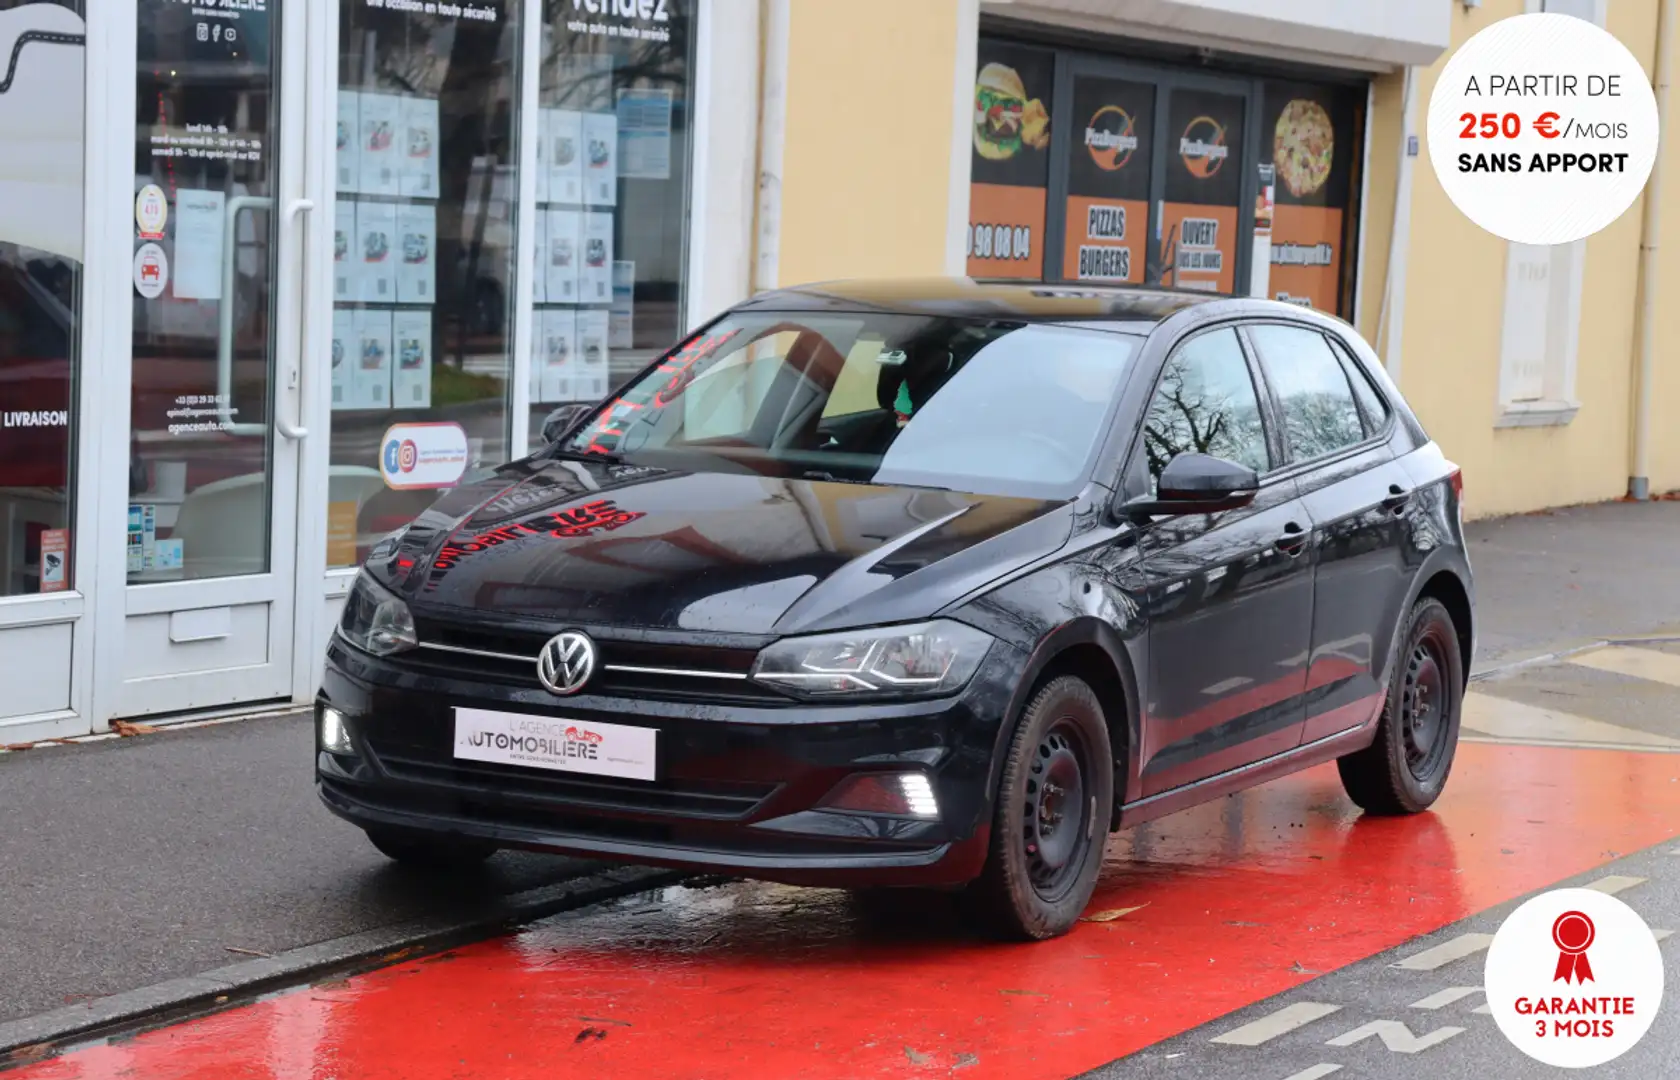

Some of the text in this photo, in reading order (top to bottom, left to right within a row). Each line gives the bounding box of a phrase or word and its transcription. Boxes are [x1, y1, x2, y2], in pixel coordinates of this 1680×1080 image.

[462, 3, 497, 21] sécurité
[1088, 207, 1125, 237] PIZZAS
[1182, 219, 1218, 246] OUVERT
[1079, 248, 1129, 278] BURGERS
[4, 410, 68, 427] LIVRAISON
